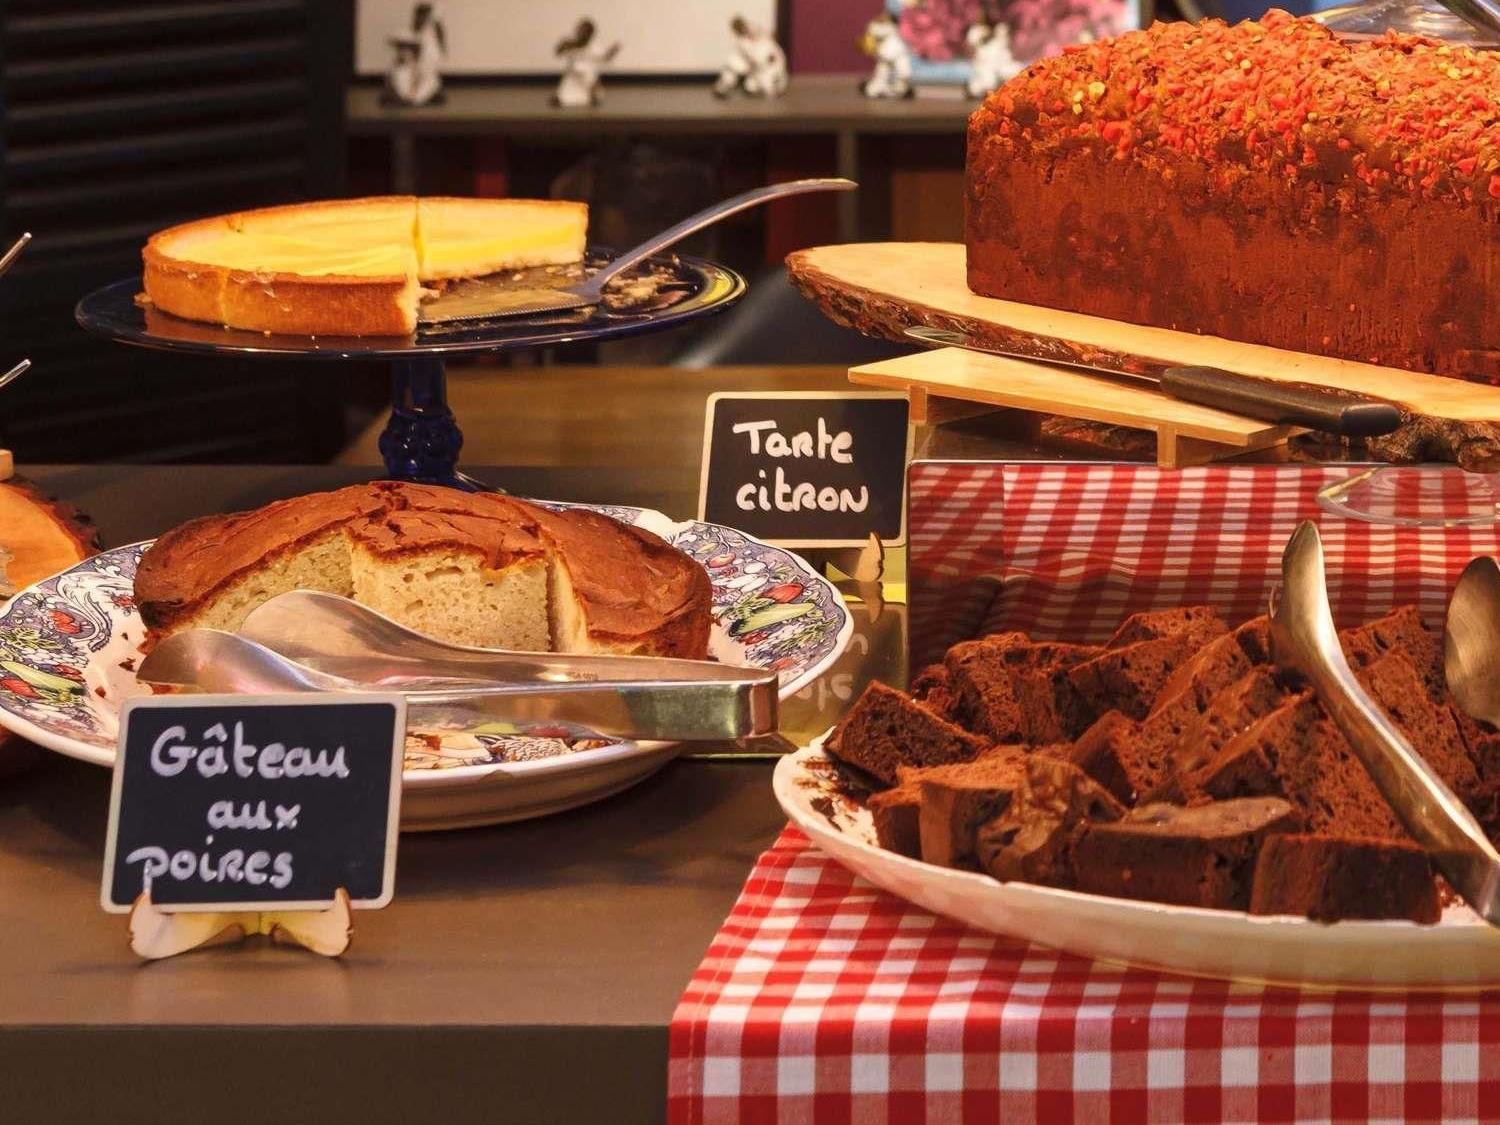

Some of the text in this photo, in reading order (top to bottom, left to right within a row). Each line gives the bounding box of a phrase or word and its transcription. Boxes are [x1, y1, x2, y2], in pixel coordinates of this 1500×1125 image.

[732, 417, 853, 463] Tarte
[736, 467, 868, 513] citron
[150, 721, 350, 779] Gâteau
[207, 800, 302, 830] aux
[125, 835, 294, 893] poires
